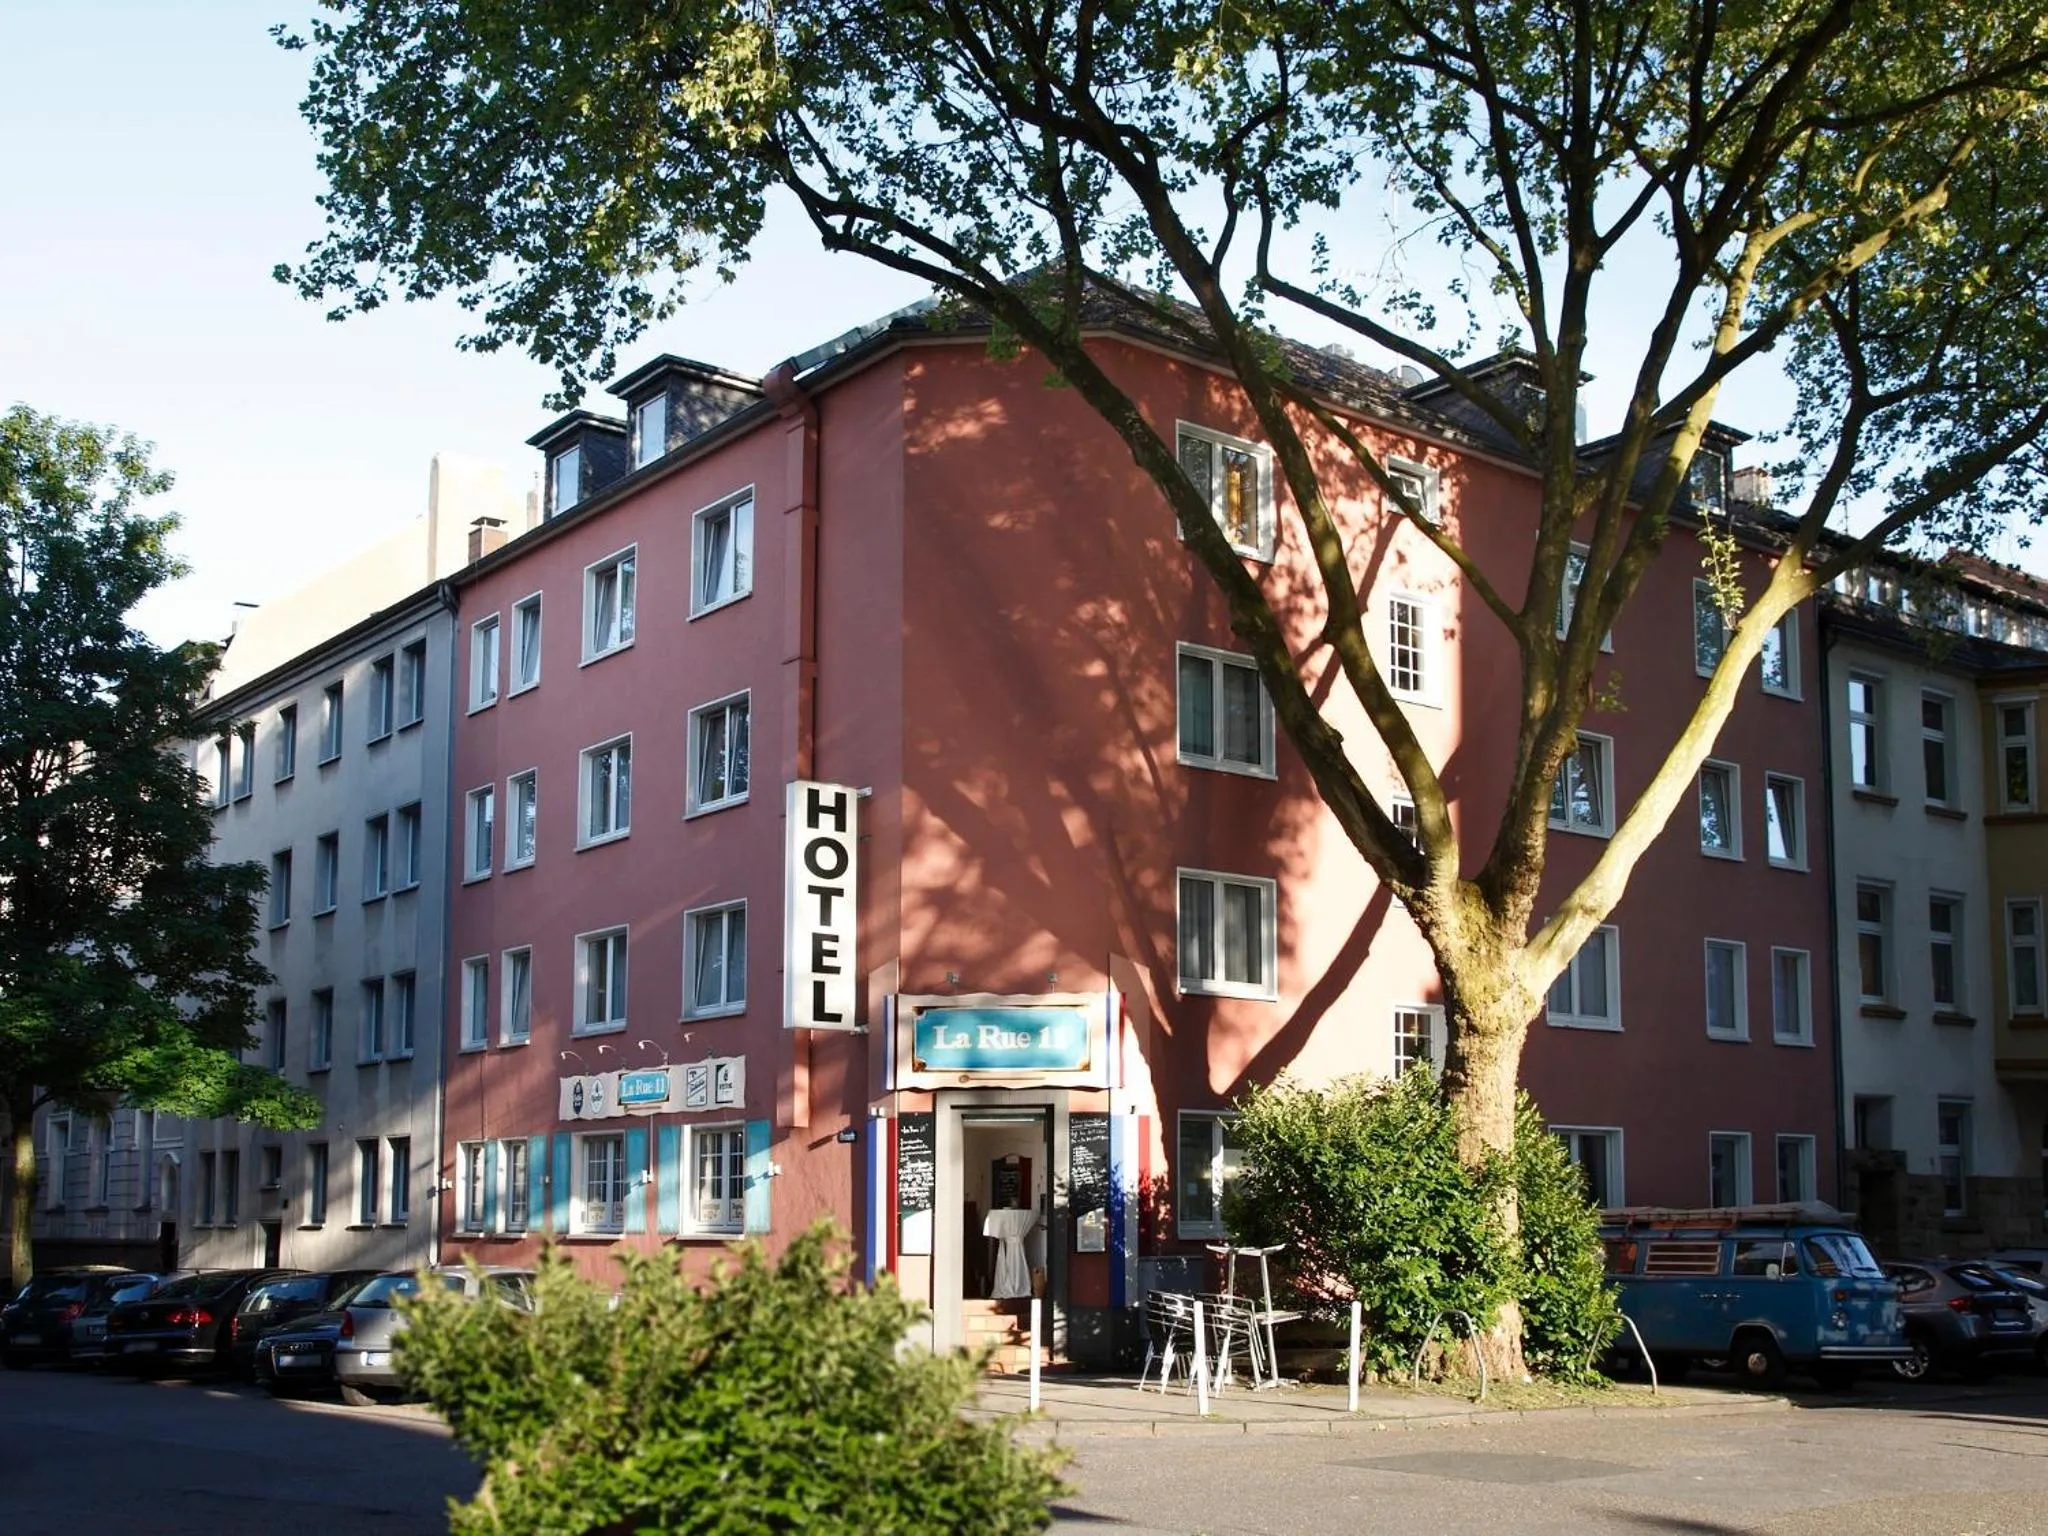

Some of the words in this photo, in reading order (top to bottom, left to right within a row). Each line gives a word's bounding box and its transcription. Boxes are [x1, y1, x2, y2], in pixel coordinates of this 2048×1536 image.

[804, 788, 849, 1023] HOTEL
[932, 1024, 972, 1050] La
[977, 1023, 1031, 1050] Rue
[621, 1080, 633, 1097] La
[635, 1079, 654, 1096] Rue
